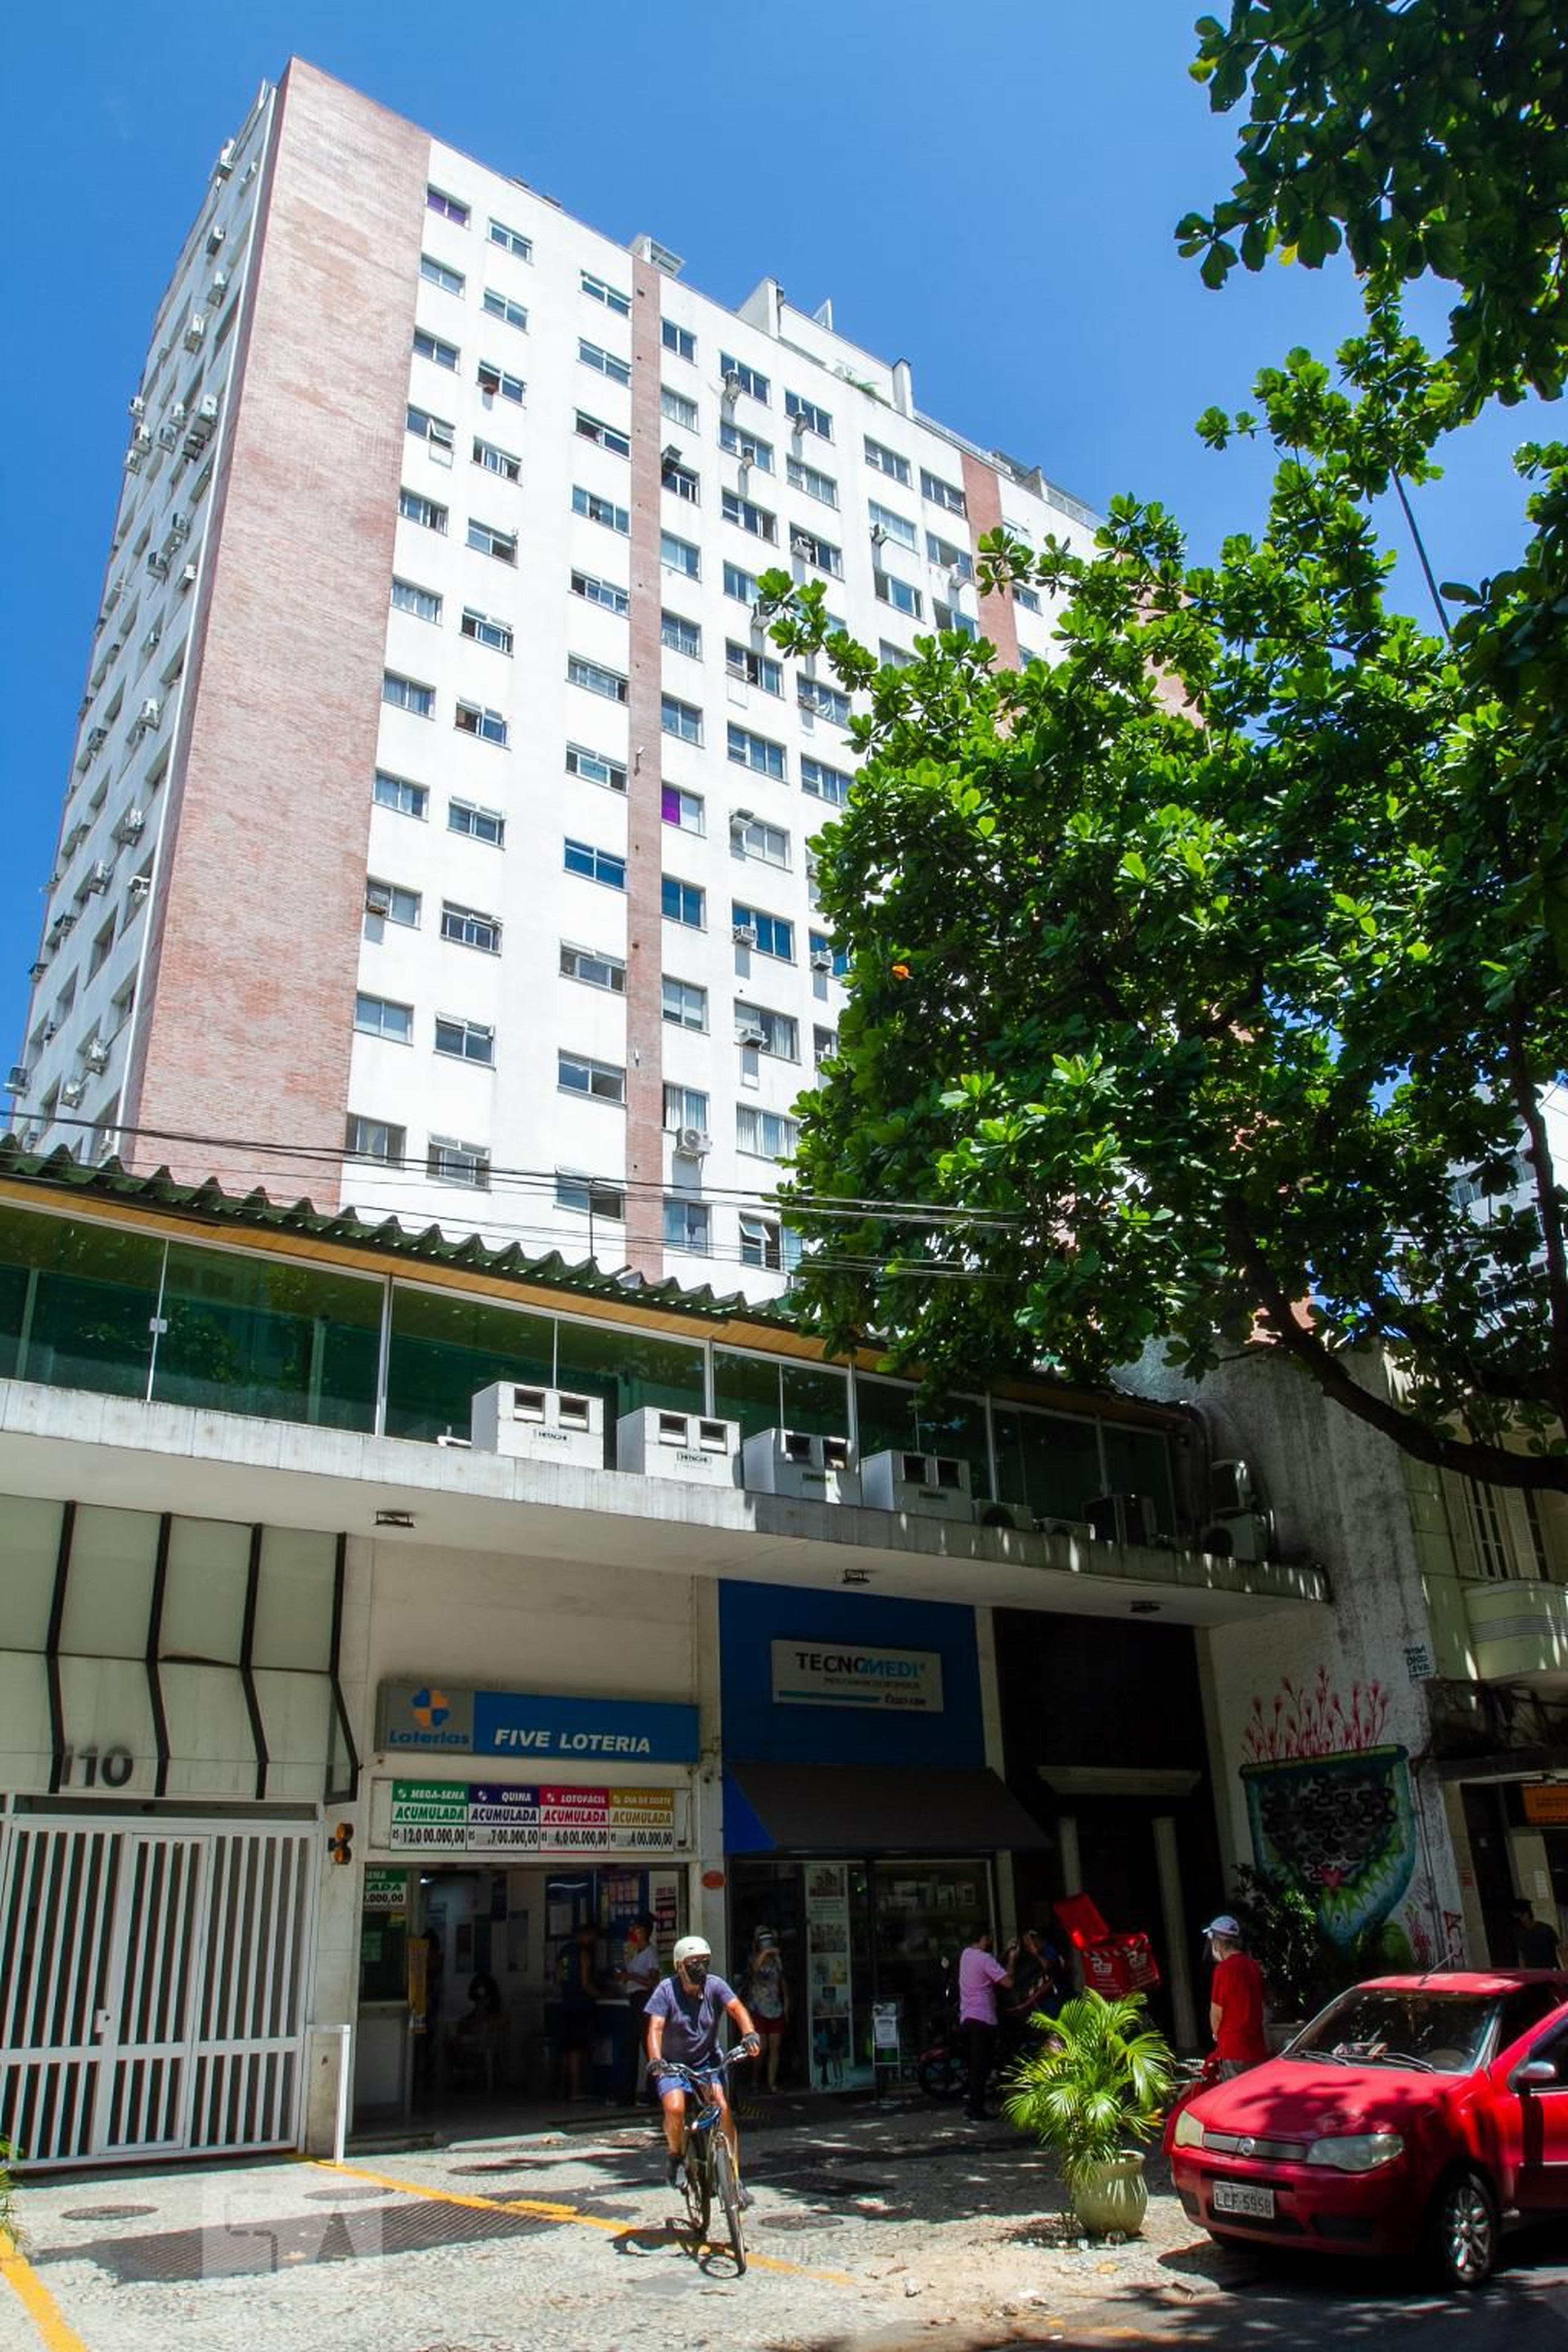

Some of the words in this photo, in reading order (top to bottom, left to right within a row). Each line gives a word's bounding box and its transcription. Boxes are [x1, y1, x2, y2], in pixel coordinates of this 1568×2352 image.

[390, 1730, 469, 1745] Loterias
[494, 1728, 550, 1748] FIVE
[559, 1733, 650, 1753] LOTERIA
[410, 1789, 466, 1800] MEGA-SENA
[501, 1792, 531, 1802] QUINA
[395, 1806, 465, 1820] ACUMULADA
[471, 1807, 537, 1822] ACUMULADA
[543, 1809, 606, 1822] ACUMULADA
[612, 1811, 671, 1824] ACUMULADA
